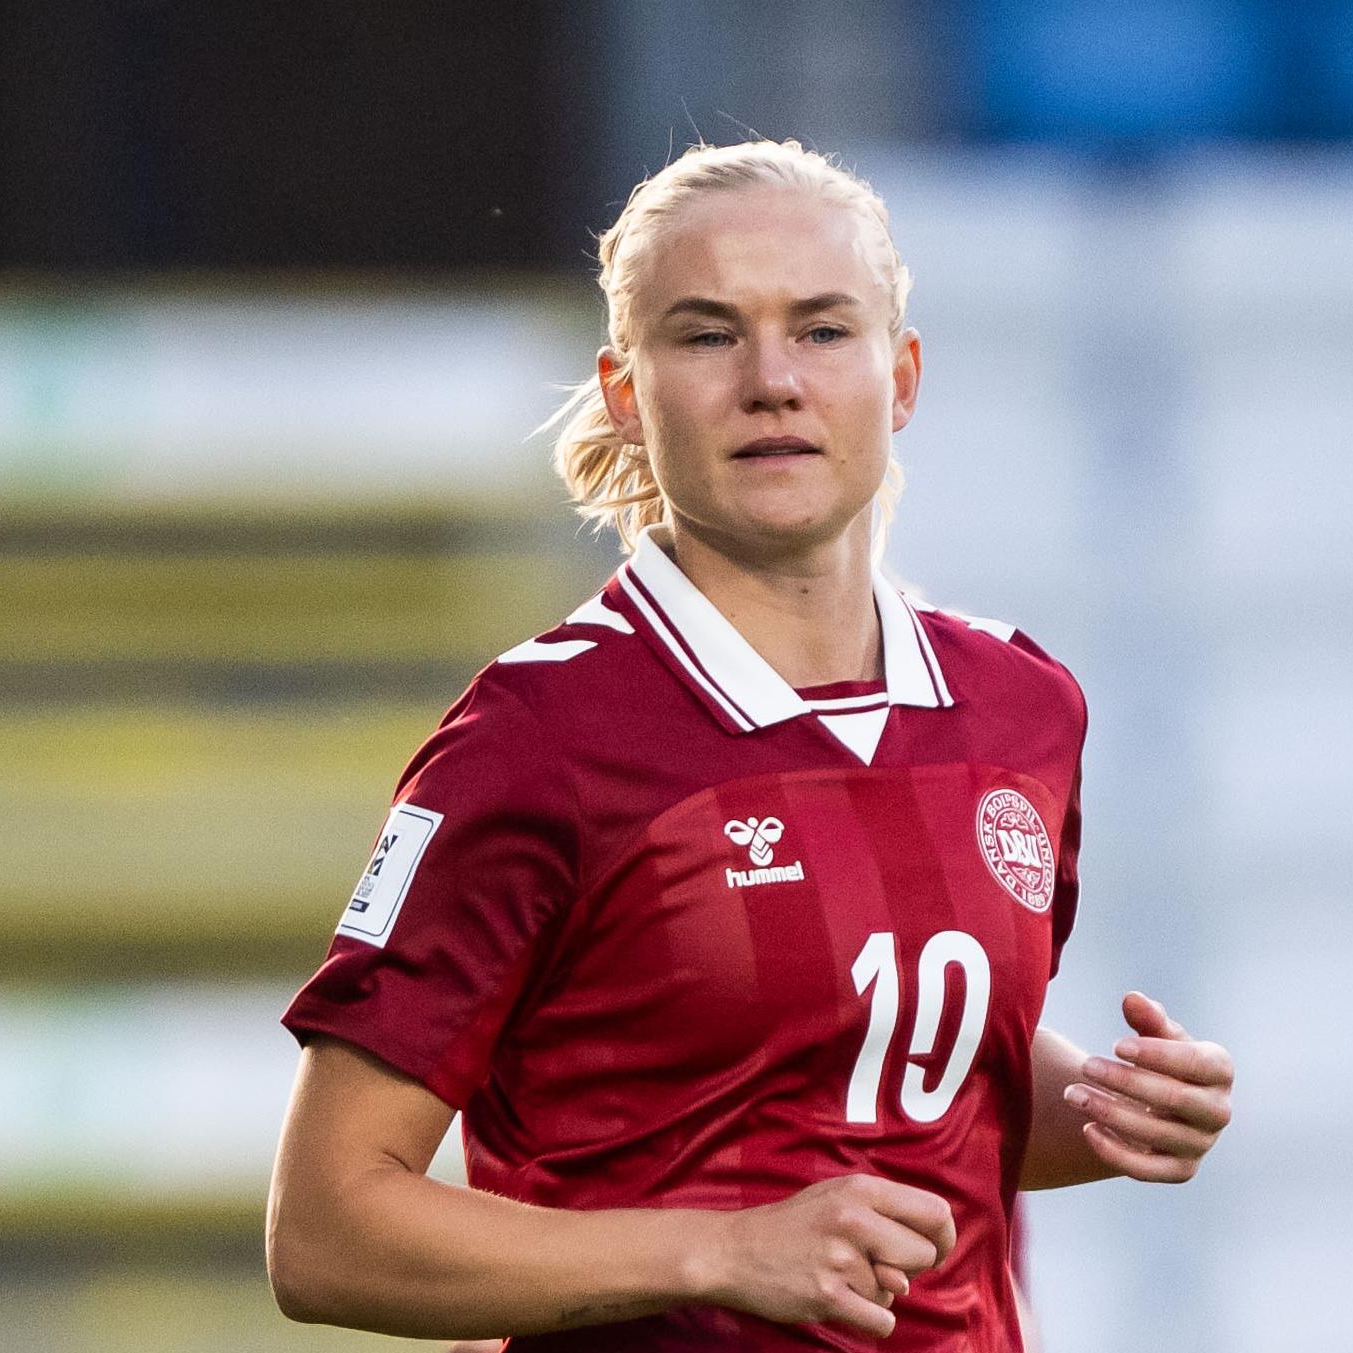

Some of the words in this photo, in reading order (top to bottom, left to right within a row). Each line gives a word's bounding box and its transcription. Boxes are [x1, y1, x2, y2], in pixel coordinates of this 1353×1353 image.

[725, 860, 805, 889] hummel
[981, 820, 1017, 890] DANSK
[1036, 831, 1053, 897] UNION
[995, 829, 1044, 869] DBU
[846, 929, 992, 1124] 10
